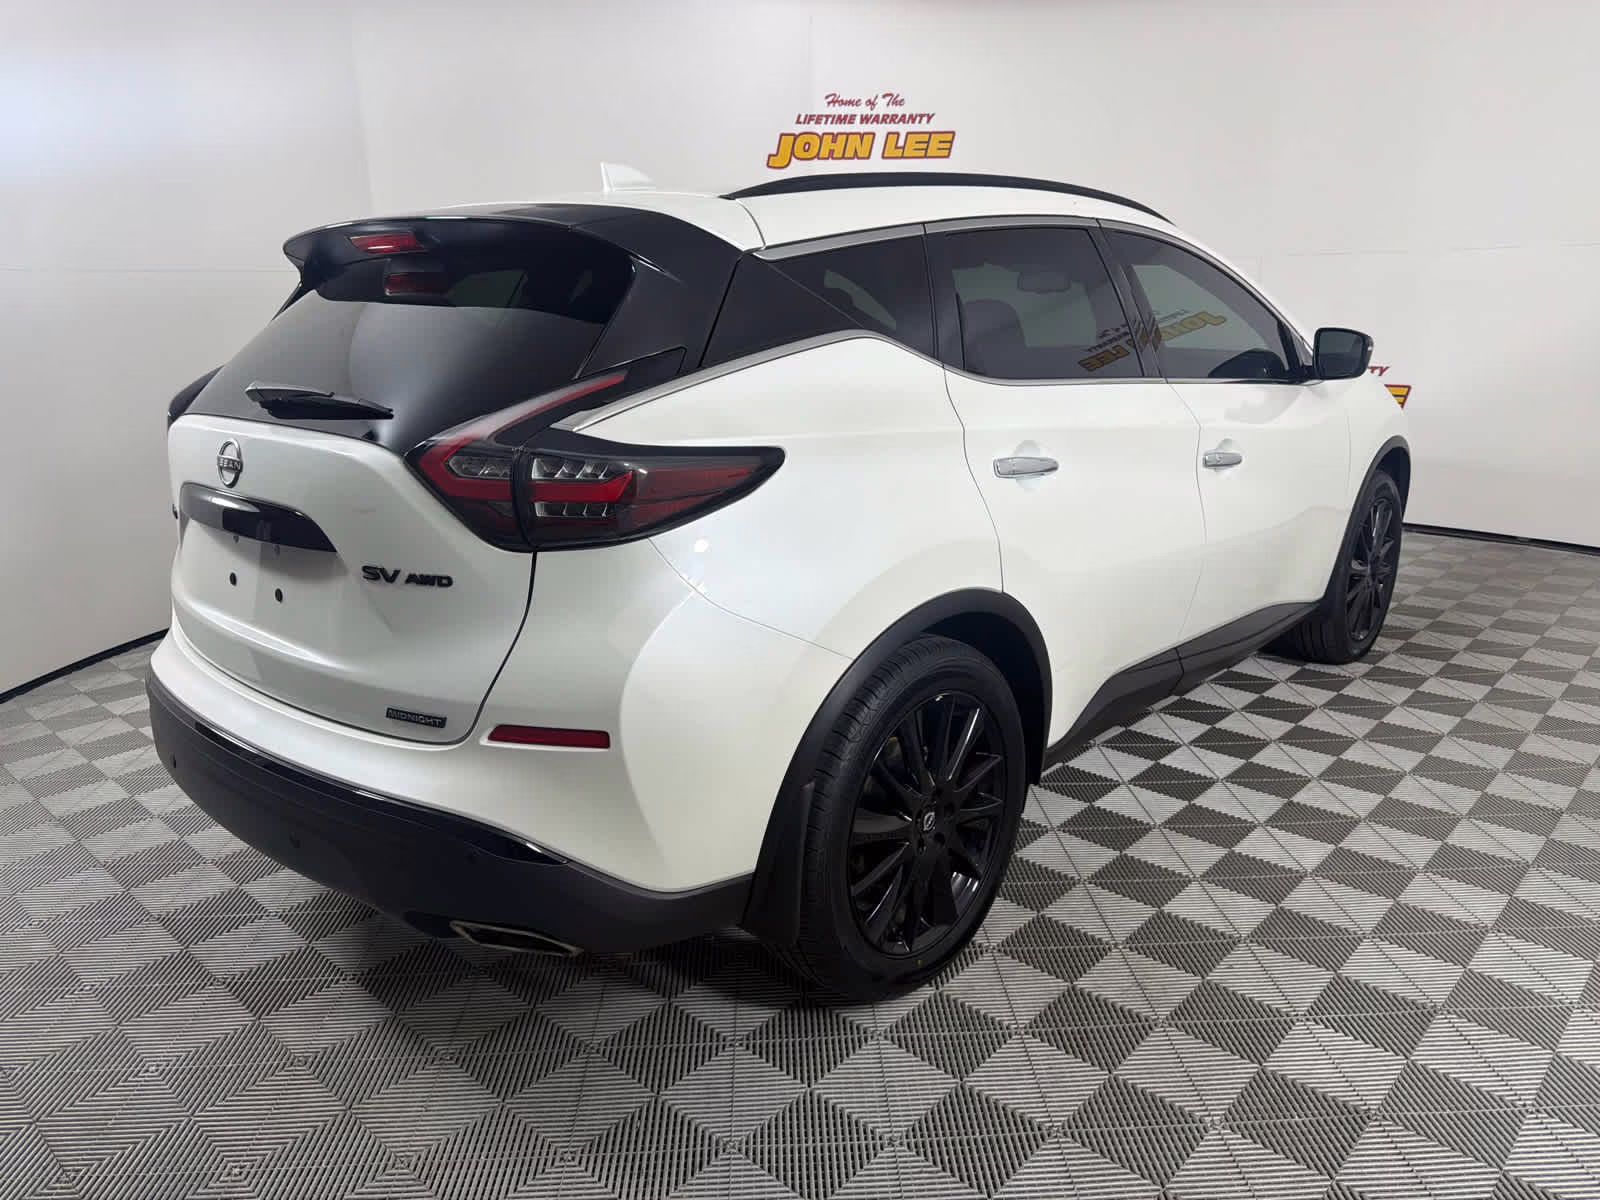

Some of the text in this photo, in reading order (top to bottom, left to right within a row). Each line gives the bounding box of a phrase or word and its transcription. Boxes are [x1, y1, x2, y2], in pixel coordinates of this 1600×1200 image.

[825, 92, 905, 111] Home of The
[795, 113, 935, 125] LIFETIME WARRANTY
[766, 131, 955, 169] JOHN LEE
[361, 565, 453, 587] SV AWD
[388, 708, 442, 728] MIDNIGHT
